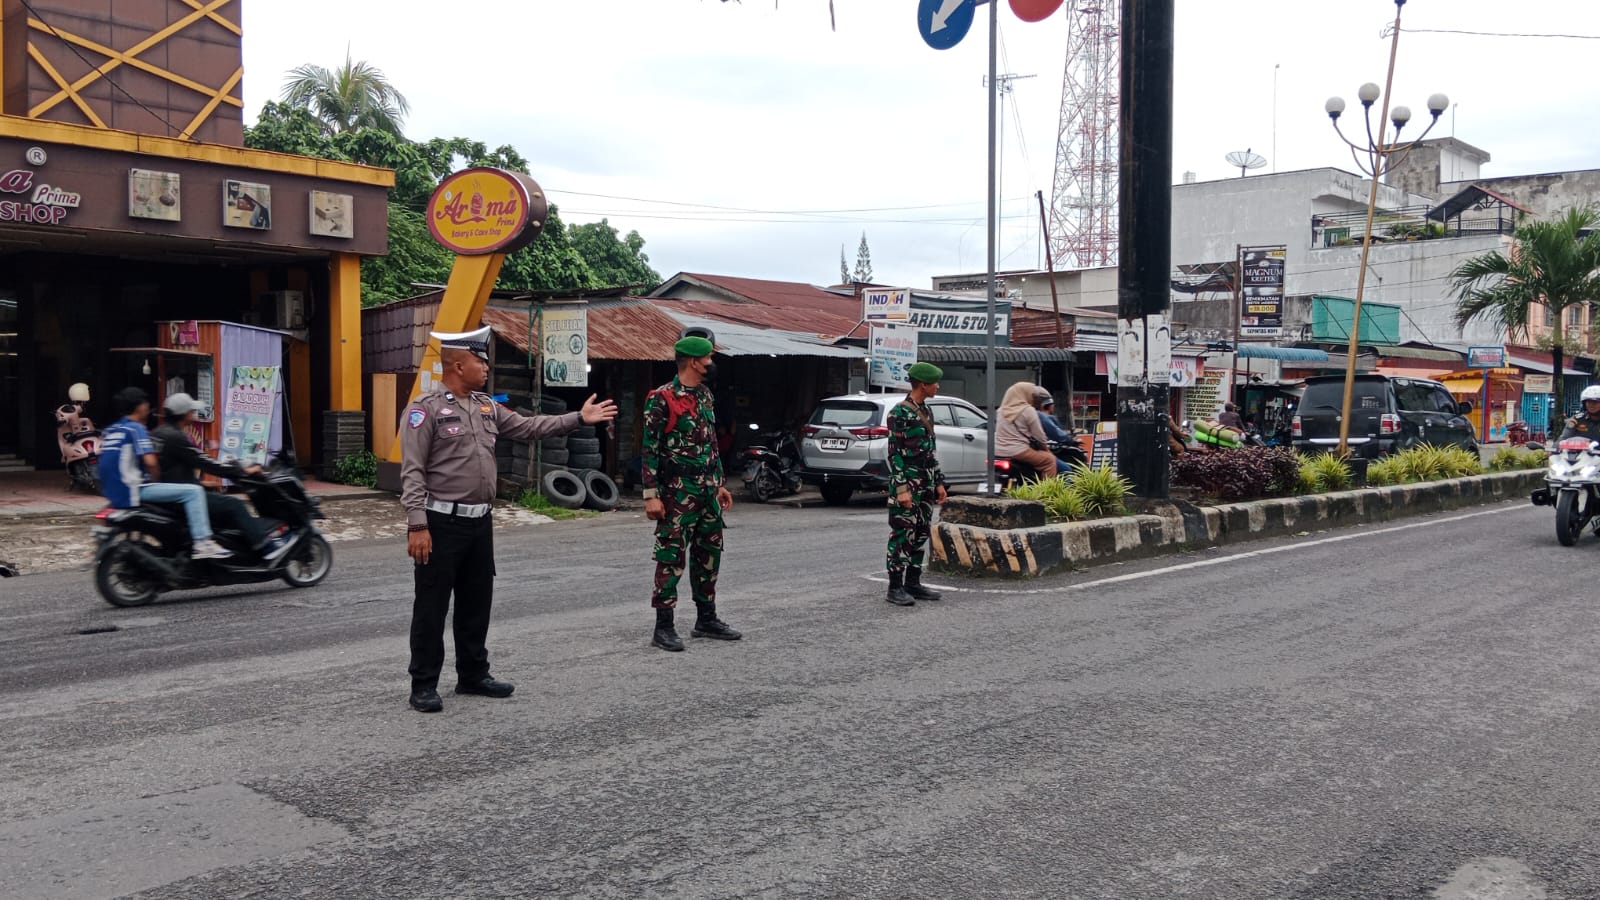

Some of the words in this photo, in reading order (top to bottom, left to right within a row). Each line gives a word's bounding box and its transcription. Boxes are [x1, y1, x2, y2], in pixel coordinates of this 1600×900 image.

[33, 184, 81, 207] Prima
[0, 201, 67, 224] SHOP
[1245, 268, 1283, 277] MAGNUM
[868, 293, 904, 307] INDAH
